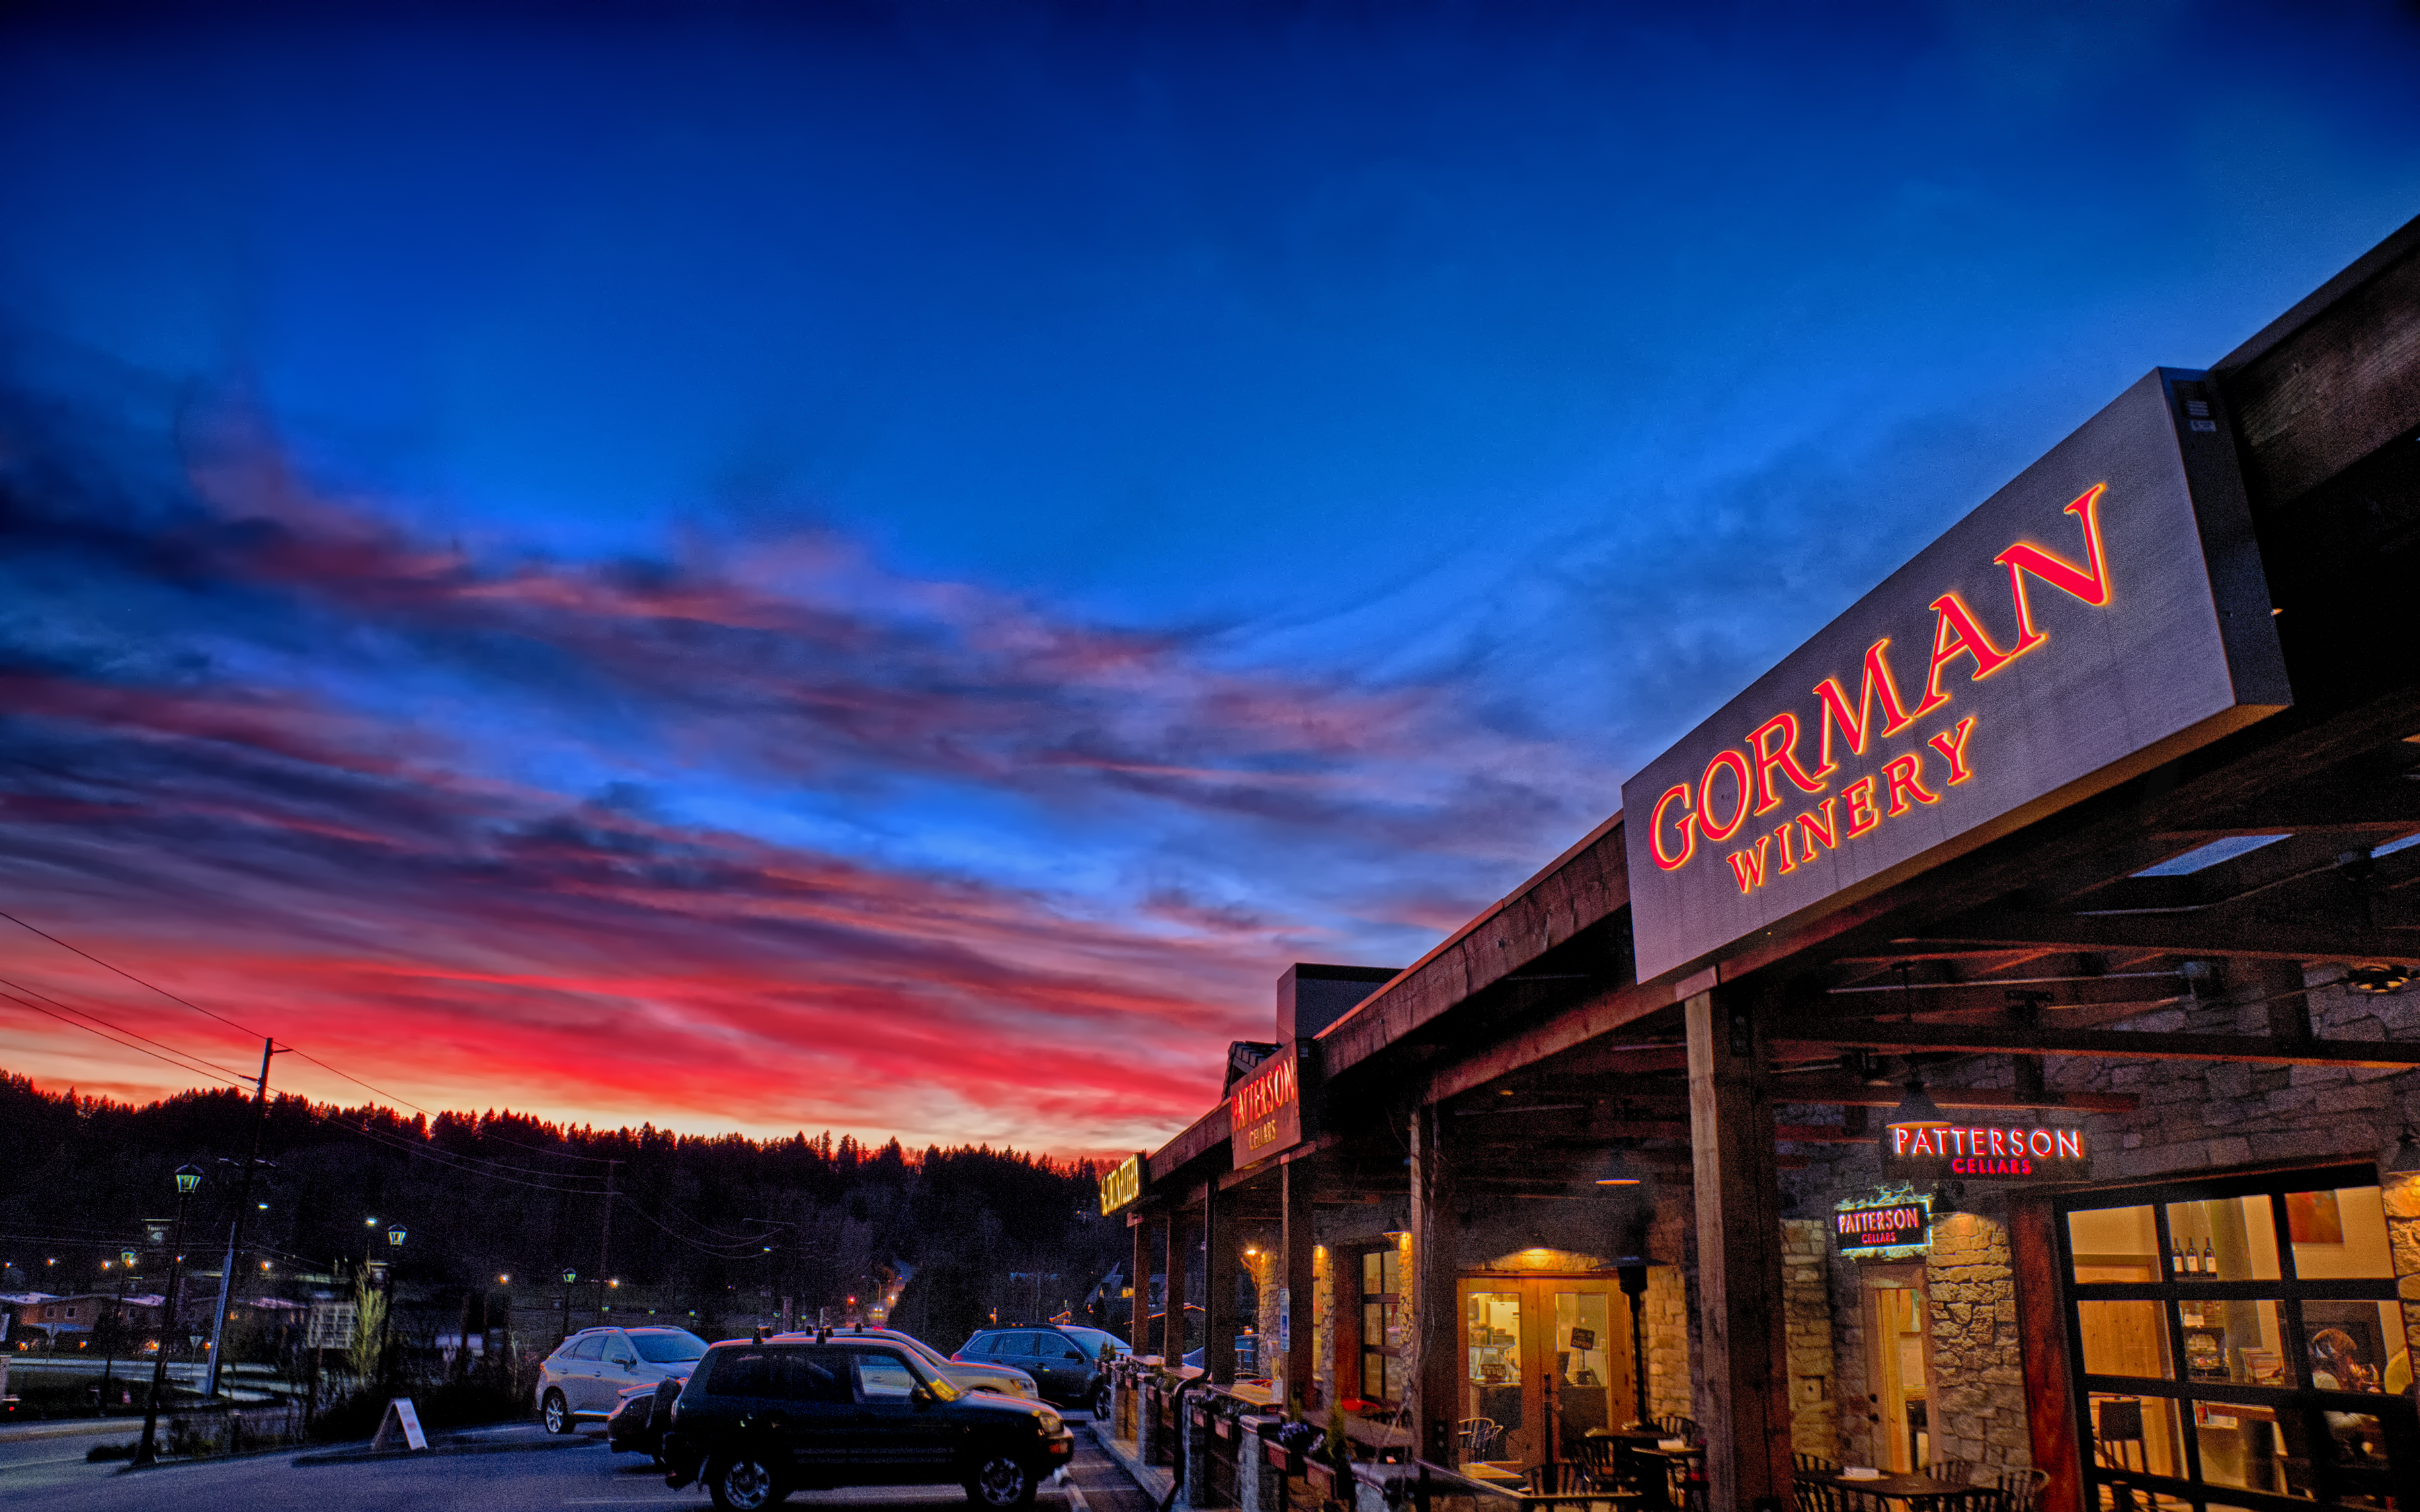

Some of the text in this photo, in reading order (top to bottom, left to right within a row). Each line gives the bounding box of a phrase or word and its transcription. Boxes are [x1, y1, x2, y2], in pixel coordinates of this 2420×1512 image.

[1648, 482, 2110, 871] GORMAN
[1726, 716, 1976, 894] WINERY
[1232, 1056, 1295, 1132] PATTERSON
[1248, 1119, 1277, 1150] CELLARS
[1896, 1127, 2083, 1158] PATTERSON
[1951, 1158, 2031, 1175] CELLARS
[1837, 1207, 1920, 1234] PATTERSON
[1861, 1231, 1897, 1245] CELLARS
